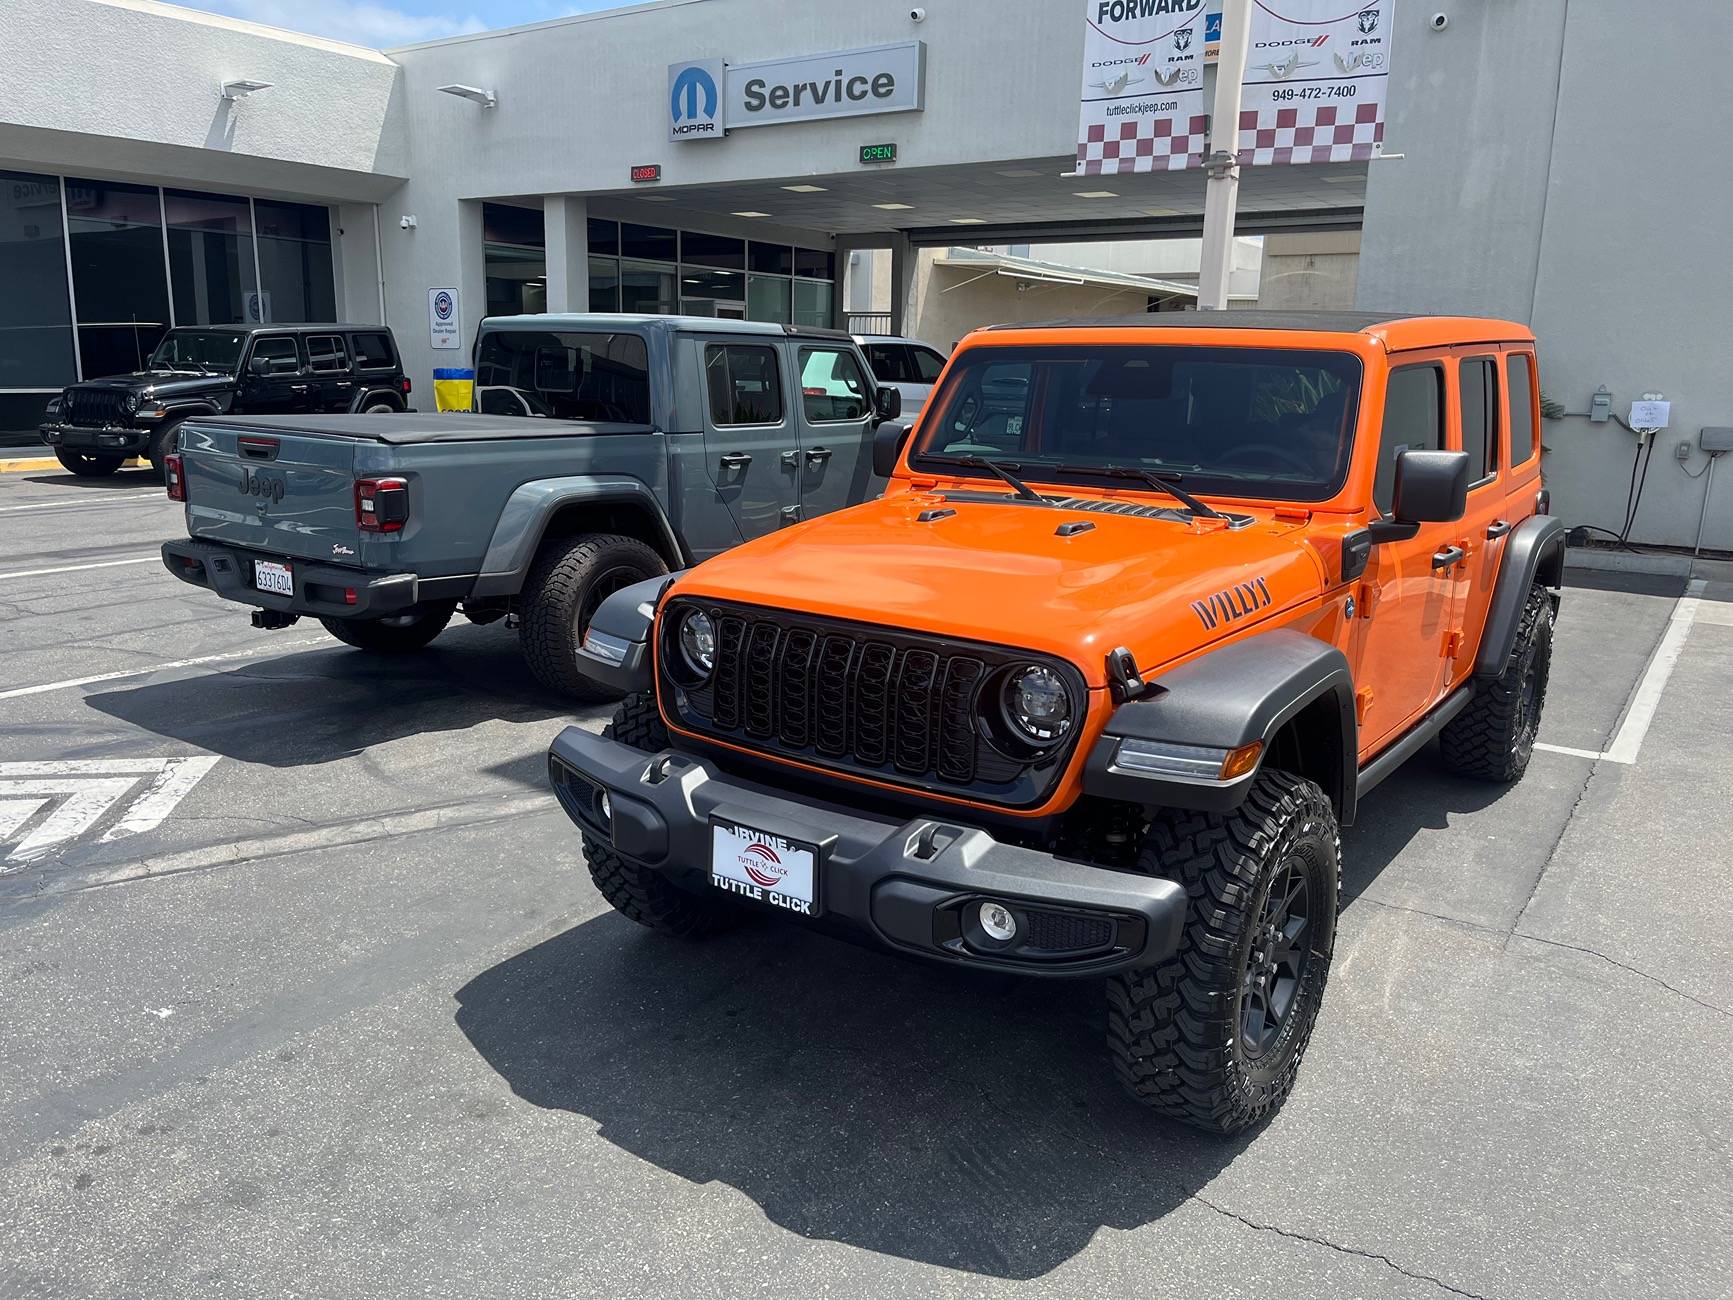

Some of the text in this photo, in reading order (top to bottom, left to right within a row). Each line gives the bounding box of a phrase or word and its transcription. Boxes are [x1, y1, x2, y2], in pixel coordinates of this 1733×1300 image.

[1255, 37, 1317, 48] DODGE
[1350, 38, 1381, 46] RAM
[1092, 56, 1142, 67] DODGE
[1168, 54, 1194, 62] RAM
[743, 69, 895, 112] Service
[1272, 85, 1356, 101] 949-472-7400
[1106, 101, 1178, 116] tuttleclickjeep.com
[672, 122, 715, 135] MOPAR
[863, 146, 892, 160] OPEN
[633, 167, 656, 180] CLOSED
[240, 468, 285, 505] Jeep
[1190, 576, 1273, 631] WILLYS
[734, 826, 788, 851] IRVINE
[738, 855, 788, 876] TUTTLE CLICK
[712, 874, 811, 915] TUTTLE CLICK
